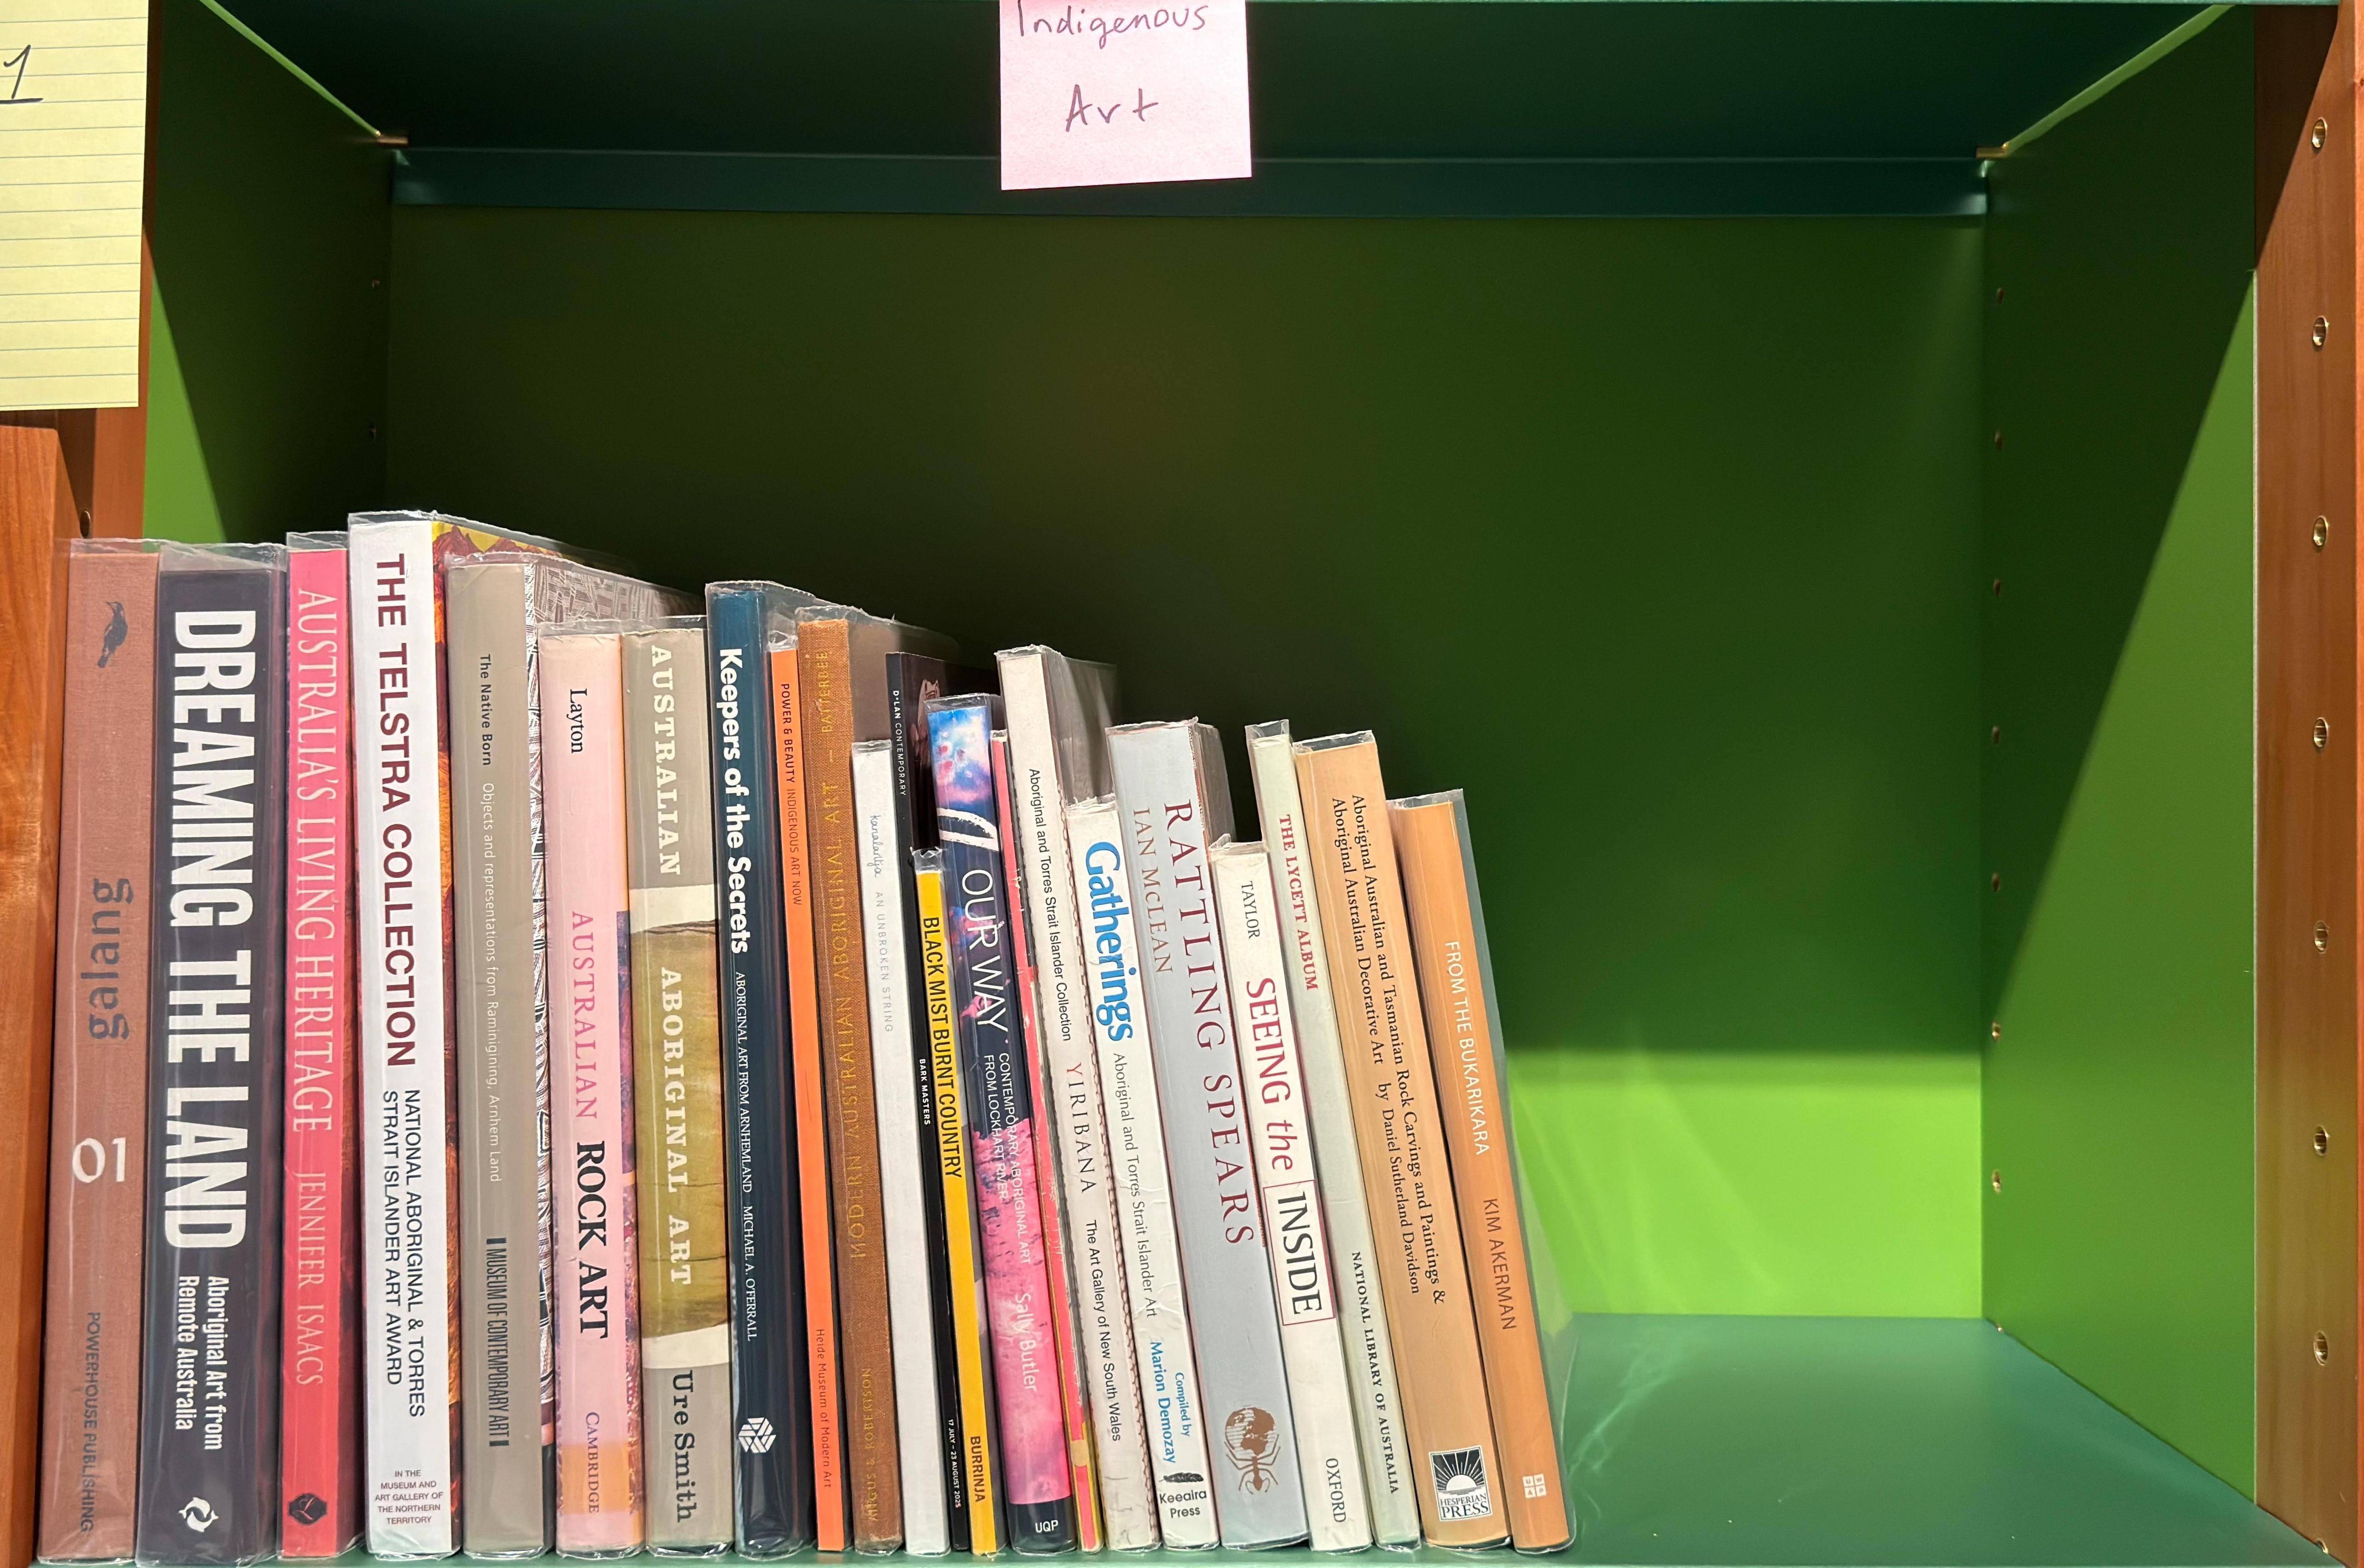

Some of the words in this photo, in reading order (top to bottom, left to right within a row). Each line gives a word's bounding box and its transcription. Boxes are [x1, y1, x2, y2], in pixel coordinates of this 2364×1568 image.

[1017, 0, 1209, 49] Indigenous
[1066, 84, 1159, 132] Art
[376, 553, 406, 628] THE
[480, 654, 491, 679] The
[379, 642, 411, 812] TELSTRA
[480, 684, 493, 728] Native
[566, 688, 587, 754] Layton
[716, 648, 743, 761] Keepers
[781, 684, 792, 724] POWER
[170, 610, 256, 927] DREAMING
[482, 733, 493, 766] Born
[651, 645, 681, 875] AUSTRALIAN
[784, 740, 795, 783] BEAUTY
[895, 723, 907, 796] CONTEMPORARY
[482, 783, 495, 830] Objects
[724, 769, 749, 796] of
[824, 782, 840, 823] ART
[1029, 769, 1047, 828] Aboriginal
[484, 835, 496, 858] and
[726, 806, 751, 849] the
[786, 789, 799, 853] INDIGENOUS
[1037, 830, 1050, 853] and
[1133, 807, 1157, 857] IAN
[1279, 814, 1295, 851] THE
[1333, 798, 1357, 874] Aboriginal
[1352, 794, 1376, 871] Aboriginal
[294, 816, 336, 941] LIVING
[791, 857, 800, 877] ART
[792, 881, 802, 906] NOW
[1040, 856, 1053, 894] Torres
[1286, 856, 1308, 923] LYCETT
[483, 863, 496, 962] representations
[727, 856, 752, 954] Secrets
[828, 838, 850, 980] ABORIGINAL
[875, 892, 884, 907] AN
[962, 869, 999, 950] OUR
[1045, 897, 1058, 929] Strait
[1141, 866, 1173, 973] MCLEAN
[1240, 881, 1261, 940] TAYLOR
[1345, 878, 1366, 952] Australian
[1365, 875, 1385, 949] Australian
[81, 878, 134, 1040] galang
[383, 823, 416, 1067] COLLECTION
[877, 914, 889, 981] UNBROKEN
[923, 916, 944, 976] BLACK
[1050, 932, 1064, 980] Islander
[1085, 841, 1137, 1042] Gatherings
[1297, 929, 1318, 991] ALBUM
[1378, 954, 1394, 980] and
[1445, 941, 1466, 994] FROM
[168, 949, 251, 1063] THE
[485, 967, 496, 996] from
[883, 987, 893, 1032] STRING
[928, 980, 949, 1024] MIST
[971, 954, 1008, 1033] WAY
[1056, 982, 1072, 1042] Collection
[1357, 956, 1379, 1036] Decorative
[293, 955, 335, 1133] HERITAGE
[572, 911, 598, 1119] AUSTRALIAN
[1164, 799, 1225, 1051] RATTLING
[1203, 1074, 1254, 1244] SPEARS
[1246, 978, 1291, 1104] SEEING
[1383, 985, 1404, 1065] Tasmanian
[1453, 997, 1472, 1034] THE
[661, 967, 688, 1193] ABORIGINAL
[837, 995, 860, 1140] AUSTRALIAN
[934, 1029, 954, 1089] BURNT
[1371, 1040, 1385, 1064] Art
[921, 1085, 930, 1125] MASTERS
[999, 1052, 1018, 1156] CONTEMPORARY
[1113, 1052, 1135, 1122] Aboriginal
[1375, 1083, 1392, 1101] by
[1396, 1068, 1415, 1108] Rock
[1459, 1038, 1490, 1156] BUKARIKARA
[383, 1091, 399, 1158] STRAIT
[405, 1090, 421, 1185] NATIONAL
[489, 1095, 500, 1146] Arnhem
[938, 1093, 962, 1179] COUNTRY
[1066, 1062, 1097, 1194] YIRIBANA
[1123, 1125, 1138, 1151] and
[1266, 1119, 1298, 1171] the
[1382, 1109, 1400, 1152] Daniel
[1404, 1111, 1422, 1177] Carvings
[72, 1137, 126, 1182] 01
[165, 1086, 249, 1248] LAND
[490, 1150, 502, 1182] Land
[1127, 1154, 1140, 1197] Torres
[384, 1165, 400, 1262] ISLANDER
[577, 1140, 607, 1252] ROCK
[847, 1154, 866, 1258] MODERN
[1010, 1160, 1029, 1239] ABORIGINAL
[1132, 1201, 1147, 1236] Strait
[1390, 1157, 1413, 1228] Sutherland
[1415, 1182, 1432, 1209] and
[1483, 1198, 1502, 1233] KIM
[293, 1171, 326, 1289] JENNIFER
[406, 1191, 424, 1312] ABORIGINAL
[668, 1214, 691, 1285] ART
[1019, 1242, 1031, 1264] ART
[1277, 1190, 1322, 1315] INSIDE
[1420, 1213, 1440, 1285] Paintings
[385, 1268, 401, 1307] ART
[1137, 1239, 1153, 1293] Islander
[1352, 1252, 1371, 1323] NATIONAL
[1403, 1231, 1421, 1294] Davidson
[1489, 1239, 1517, 1330] AKERMAN
[177, 1276, 200, 1342] Remote
[203, 1276, 229, 1365] Aboriginal
[408, 1318, 424, 1331] &
[579, 1260, 609, 1339] ART
[1015, 1292, 1035, 1337] Sally
[1144, 1296, 1157, 1318] Art
[1433, 1289, 1446, 1304] &
[83, 1312, 101, 1429] POWERHOUSE
[296, 1304, 324, 1386] ISAACS
[386, 1313, 402, 1385] AWARD
[408, 1336, 425, 1417] TORRES
[1019, 1341, 1039, 1393] Butler
[1150, 1341, 1167, 1392] Marion
[1364, 1328, 1382, 1387] LIBRARY
[175, 1347, 199, 1431] Australia
[205, 1370, 227, 1400] Art
[672, 1370, 694, 1425] Ure
[1375, 1393, 1386, 1411] OF
[204, 1405, 223, 1450] from
[1158, 1397, 1176, 1464] Demozay
[1378, 1416, 1399, 1494] AUSTRALIA
[80, 1433, 98, 1533] PUBLISHING
[585, 1411, 600, 1513] CAMBRIDGE
[674, 1432, 697, 1523] Smith
[969, 1436, 986, 1503] BURRINJA
[1325, 1458, 1347, 1523] OXFORD
[1035, 1519, 1059, 1533] UQP
[1159, 1489, 1207, 1505] Keeaira
[1170, 1507, 1201, 1519] Press
[1440, 1493, 1487, 1506] HESPERIAN
[1441, 1501, 1489, 1518] PRESS
